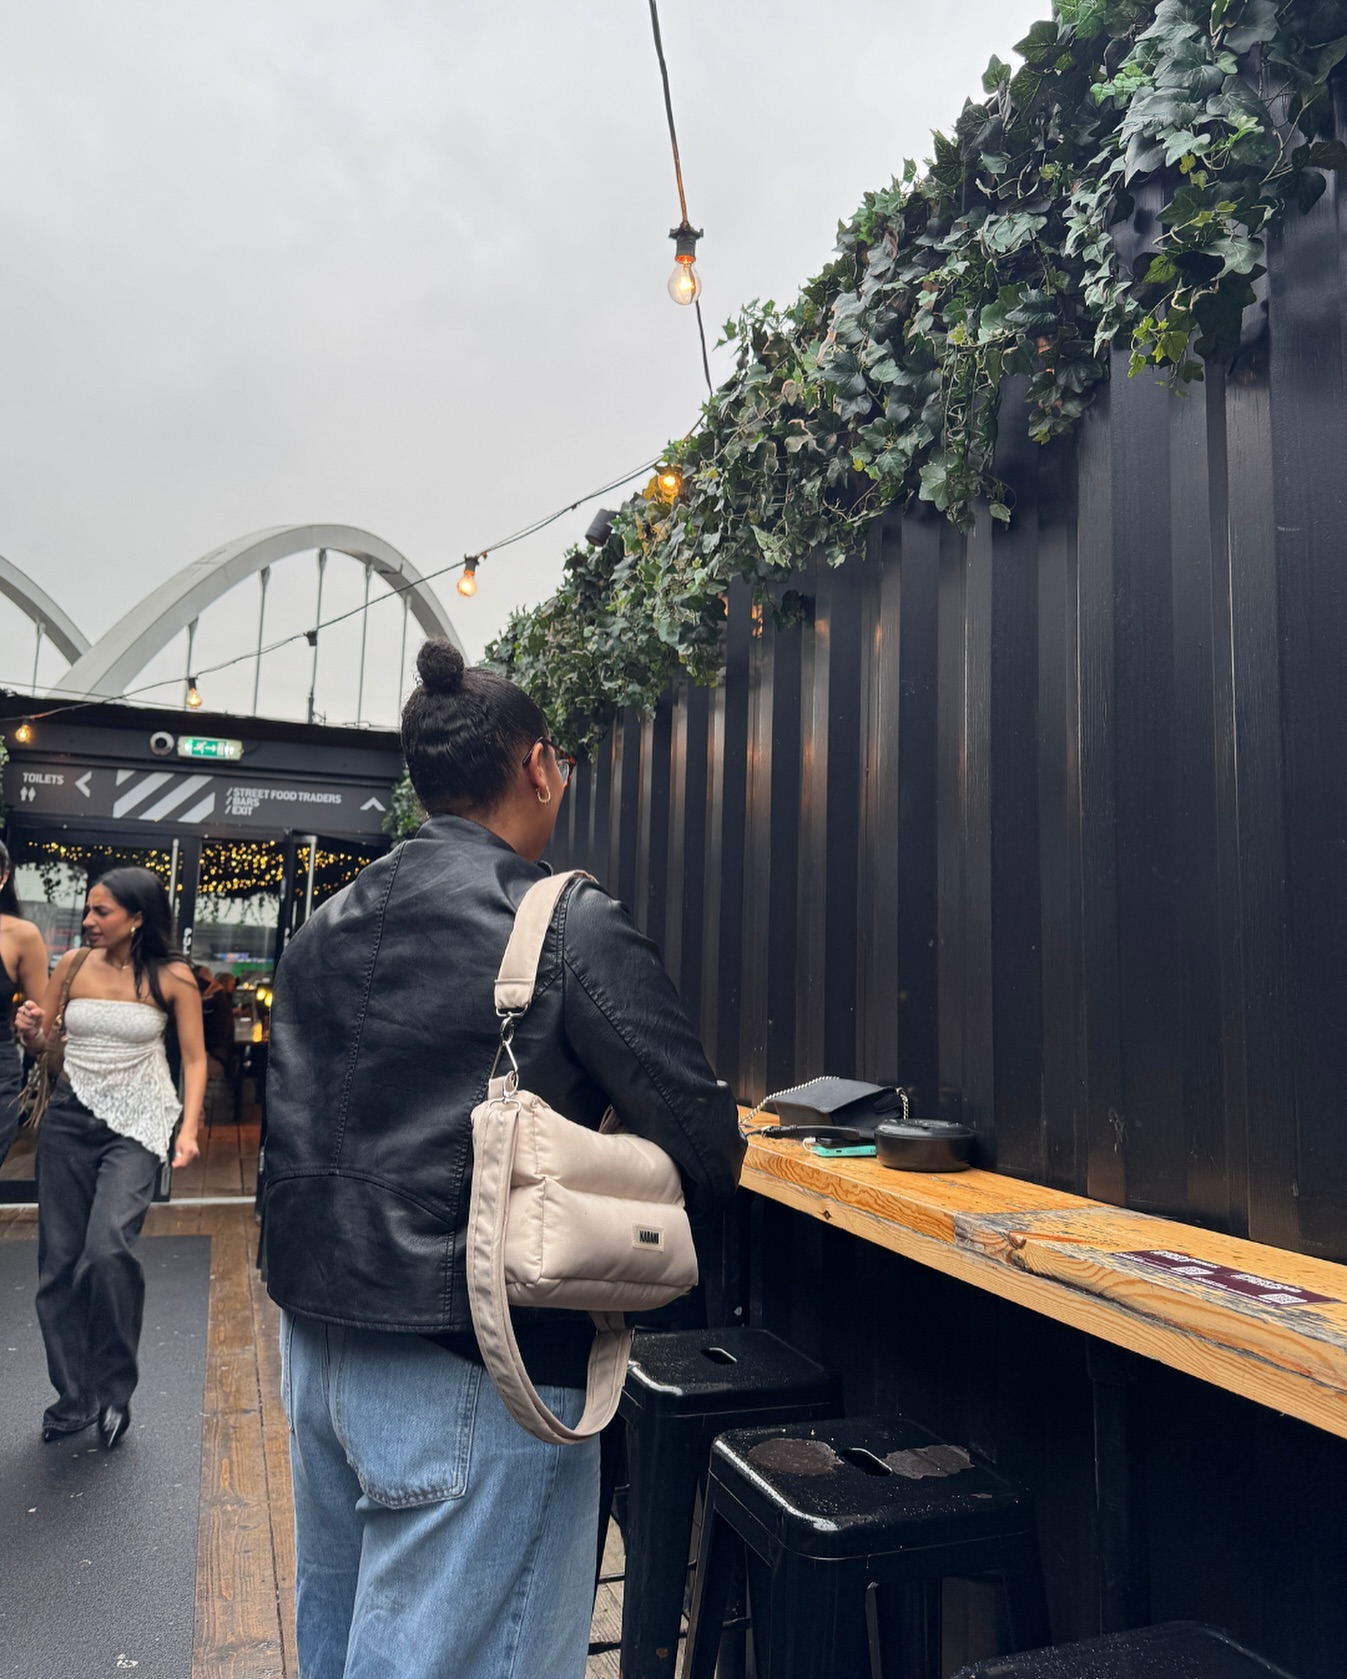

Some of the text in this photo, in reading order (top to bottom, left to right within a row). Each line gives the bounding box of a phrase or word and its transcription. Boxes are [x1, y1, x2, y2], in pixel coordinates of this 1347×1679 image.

[22, 772, 64, 785] TOILETS
[270, 790, 297, 801] FOOD
[298, 792, 342, 804] TRADERS
